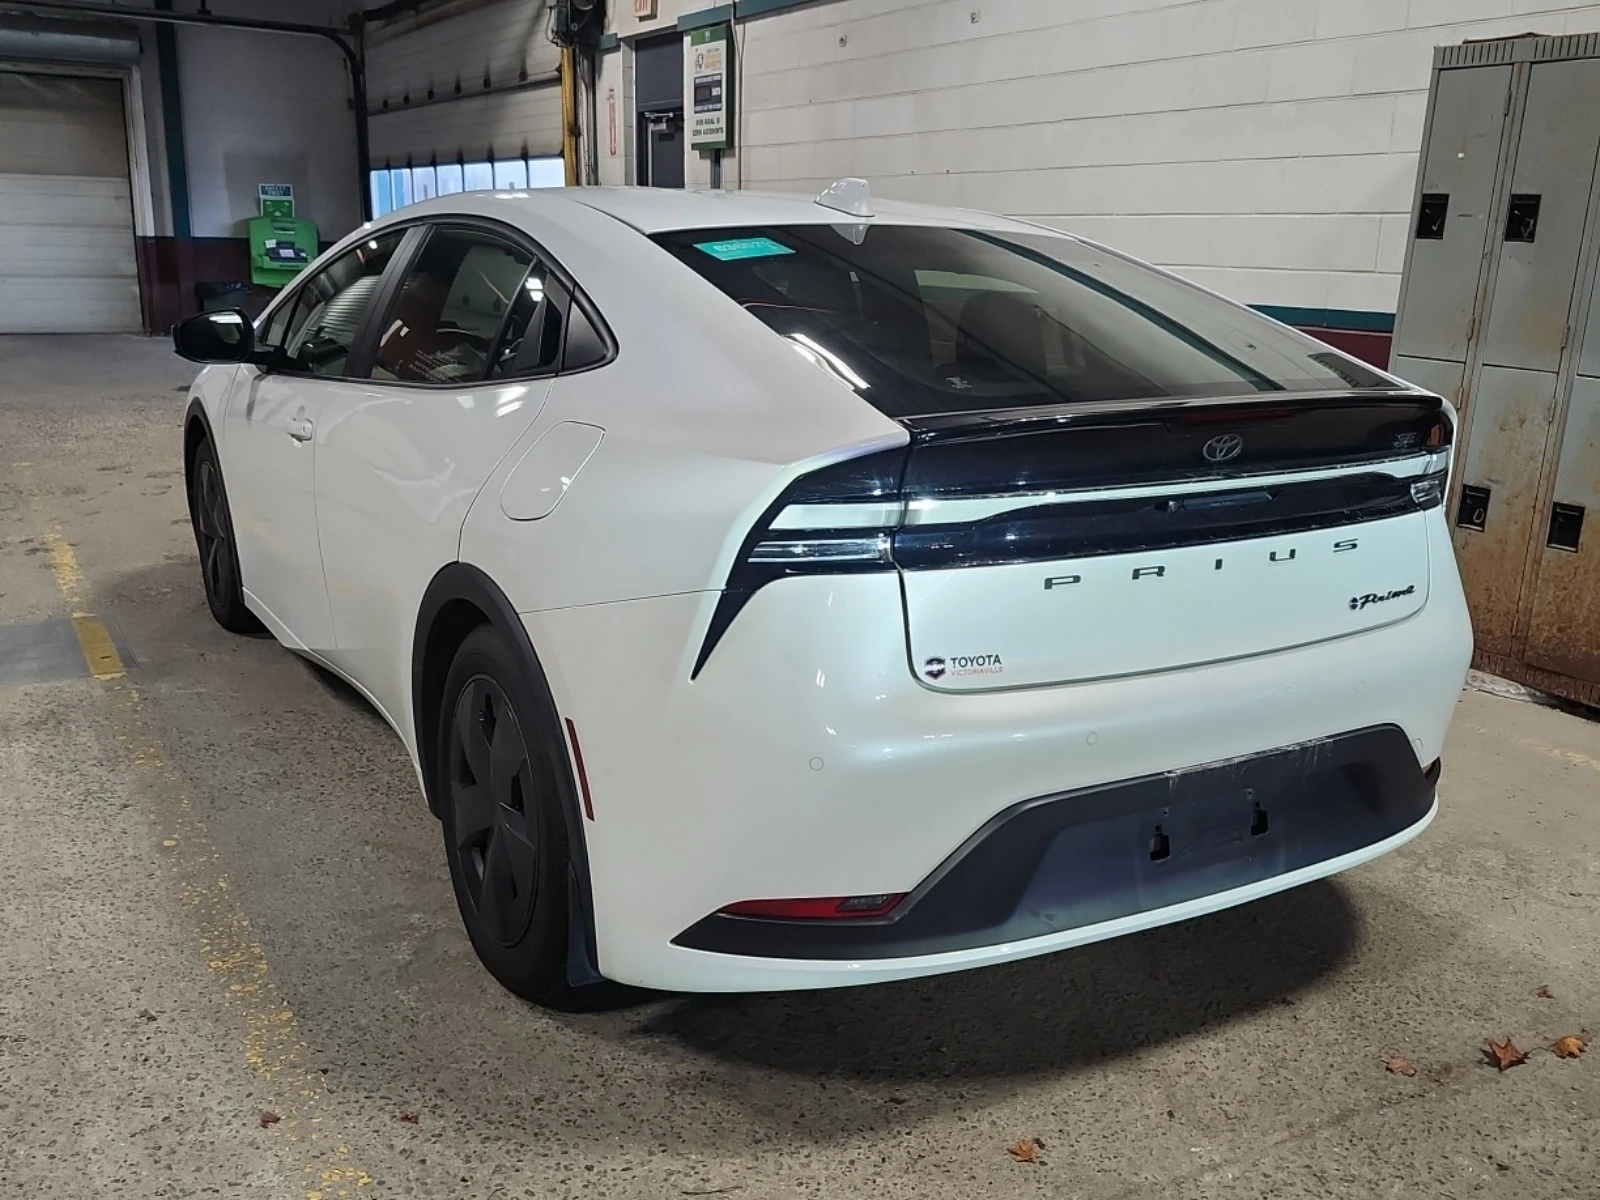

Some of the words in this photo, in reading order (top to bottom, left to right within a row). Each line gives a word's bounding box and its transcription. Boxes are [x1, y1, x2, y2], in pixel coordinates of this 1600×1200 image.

[1044, 538, 1359, 590] PRIUS
[1359, 585, 1415, 610] Prime
[950, 654, 1002, 669] TOYOTA
[951, 667, 1004, 677] VICTORIAVILLE
